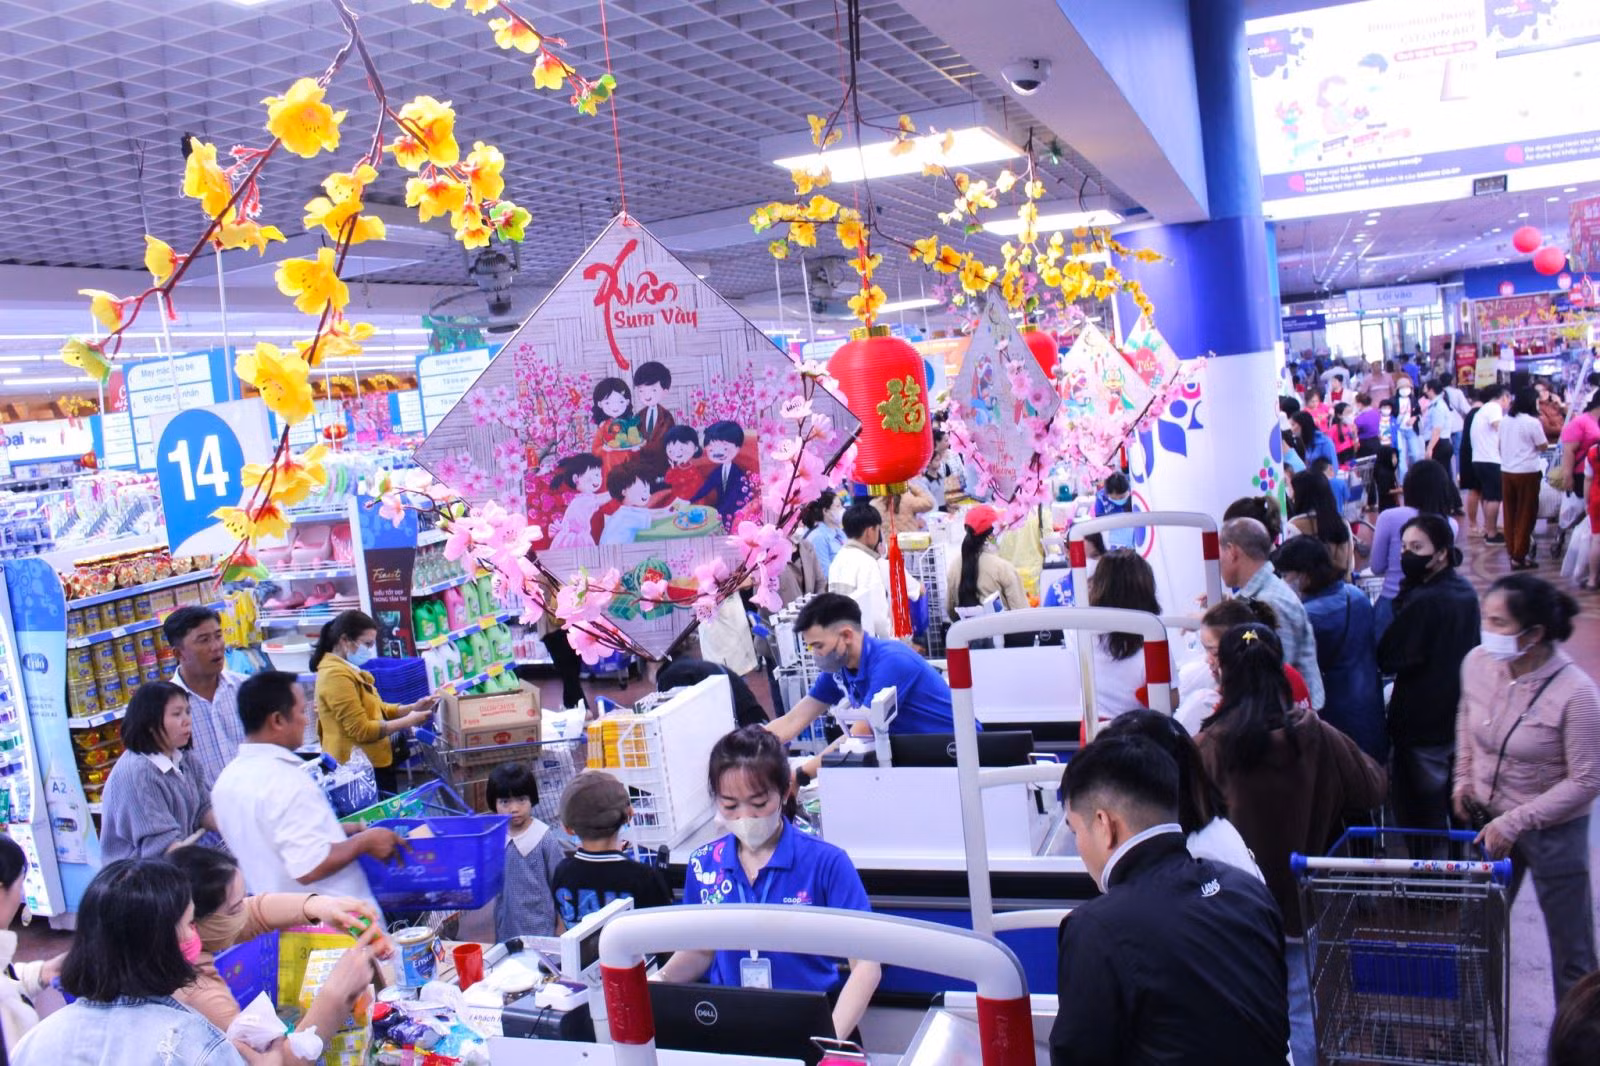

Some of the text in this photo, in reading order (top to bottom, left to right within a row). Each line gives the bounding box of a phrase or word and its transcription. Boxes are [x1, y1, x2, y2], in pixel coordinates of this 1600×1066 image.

[583, 239, 678, 370] Xuân
[614, 311, 654, 328] Sum
[877, 375, 925, 432] 福
[168, 435, 230, 501] 14
[52, 781, 67, 794] A2
[697, 1009, 715, 1018] DELL
